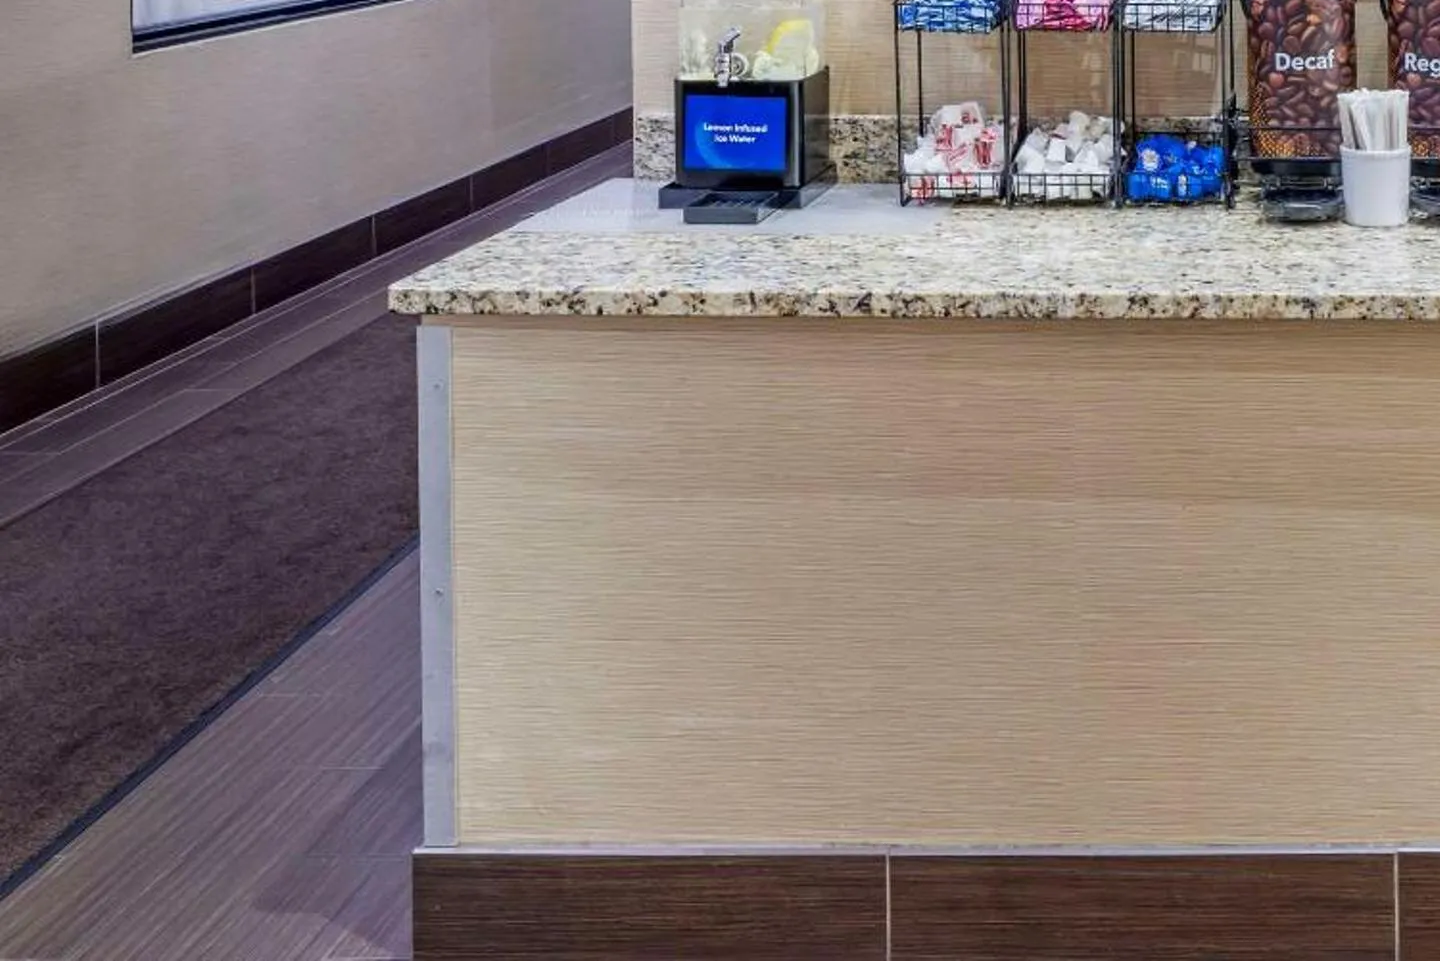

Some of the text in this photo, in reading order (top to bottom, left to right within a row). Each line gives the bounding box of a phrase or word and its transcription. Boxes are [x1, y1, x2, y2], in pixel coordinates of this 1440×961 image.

[1274, 48, 1335, 72] Decaf
[703, 121, 769, 134] Lemon Infused
[713, 134, 756, 144] Ice Water
